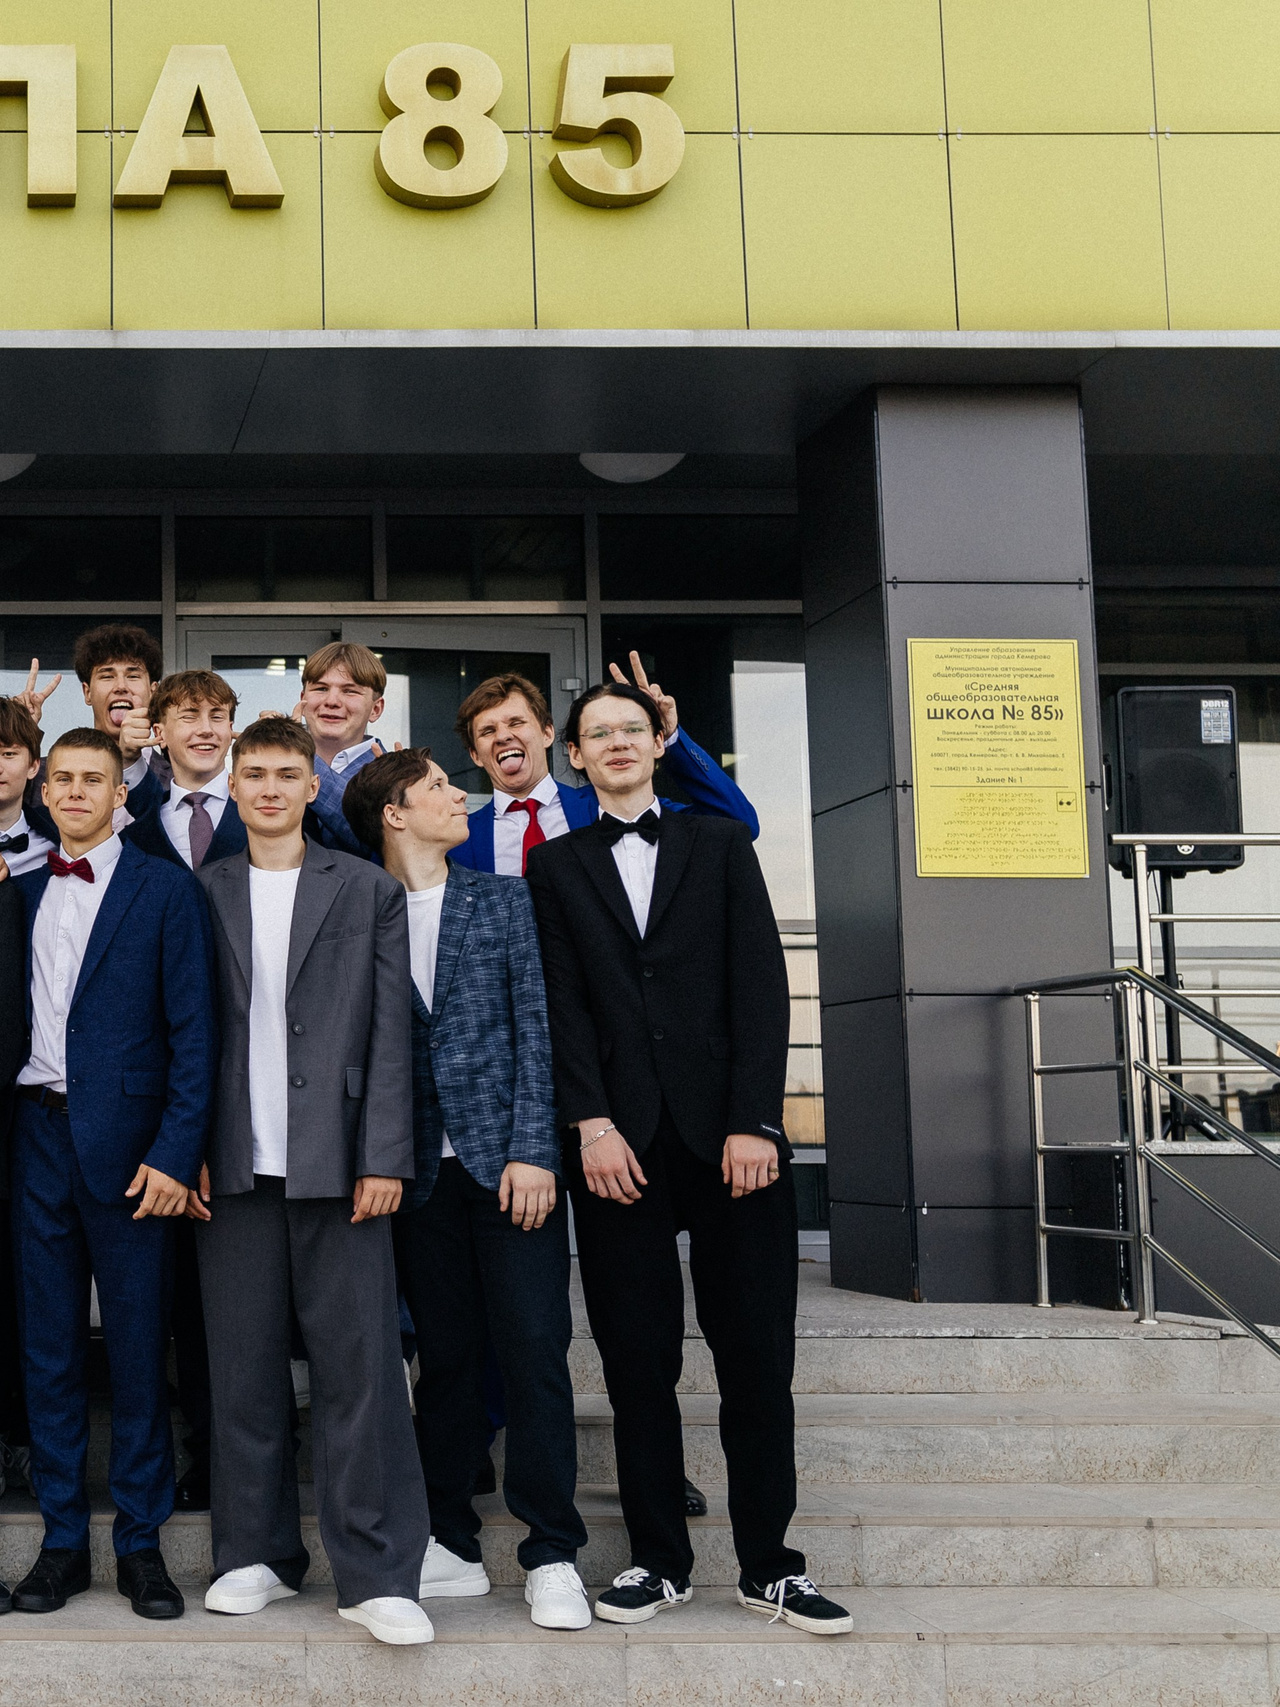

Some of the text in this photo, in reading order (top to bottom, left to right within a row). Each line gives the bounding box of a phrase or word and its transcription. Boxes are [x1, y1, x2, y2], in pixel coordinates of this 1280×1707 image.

[374, 41, 686, 208] 85
[949, 646, 1036, 654] Управление образования
[945, 665, 999, 673] Муниципальное
[964, 682, 1020, 692] «Средняя
[926, 692, 1059, 703] общеобразовательная
[926, 704, 1064, 721] школа № 85»
[976, 776, 1006, 784] Здание
